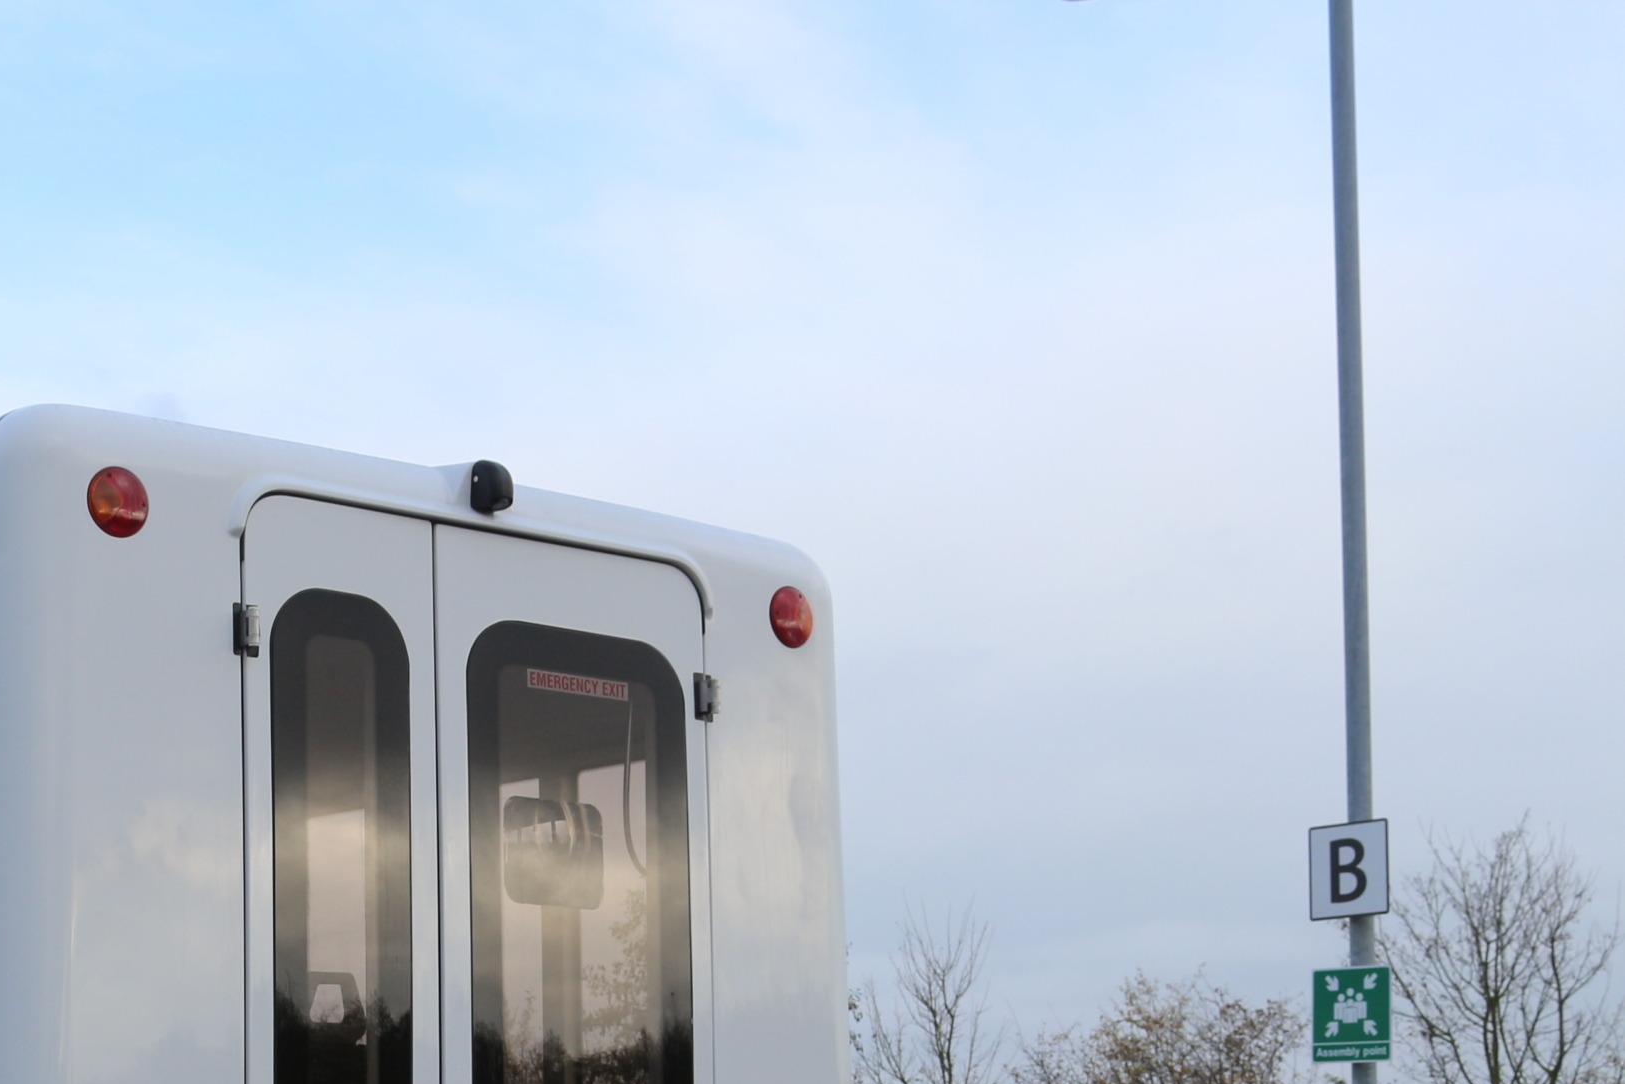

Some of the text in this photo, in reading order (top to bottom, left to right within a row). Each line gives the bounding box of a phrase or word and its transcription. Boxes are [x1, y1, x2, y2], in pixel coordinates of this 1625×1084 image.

[529, 671, 626, 698] EMERGENCY EXIT
[1330, 838, 1367, 903] B
[1316, 1046, 1387, 1058] Assembly point
